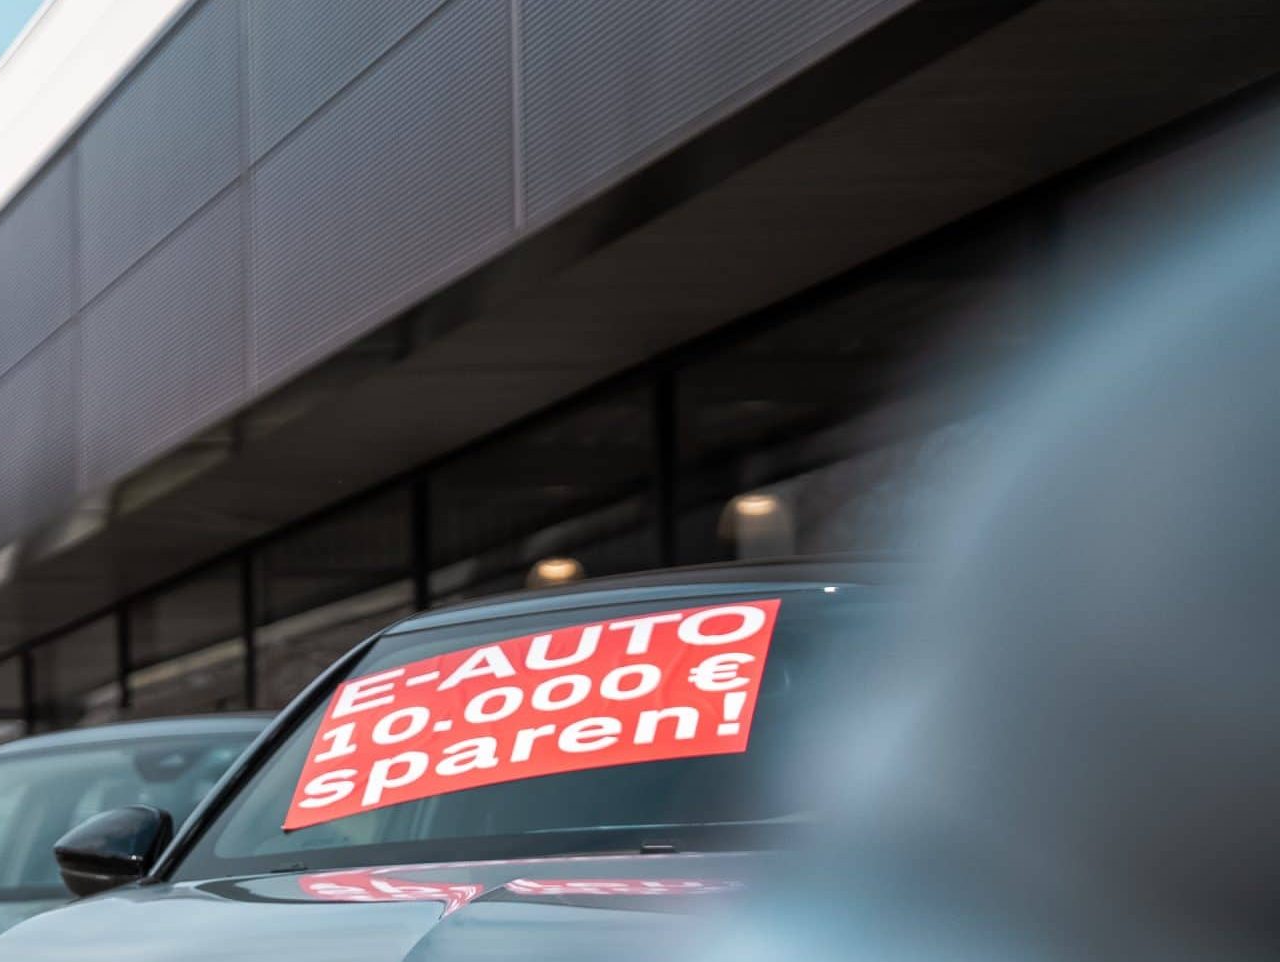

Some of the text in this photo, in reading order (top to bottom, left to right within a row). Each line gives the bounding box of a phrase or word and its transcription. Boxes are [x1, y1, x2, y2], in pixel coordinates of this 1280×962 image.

[314, 653, 756, 763] 10.000 €
[331, 606, 767, 717] E-AUTO
[298, 691, 747, 809] sparen!
